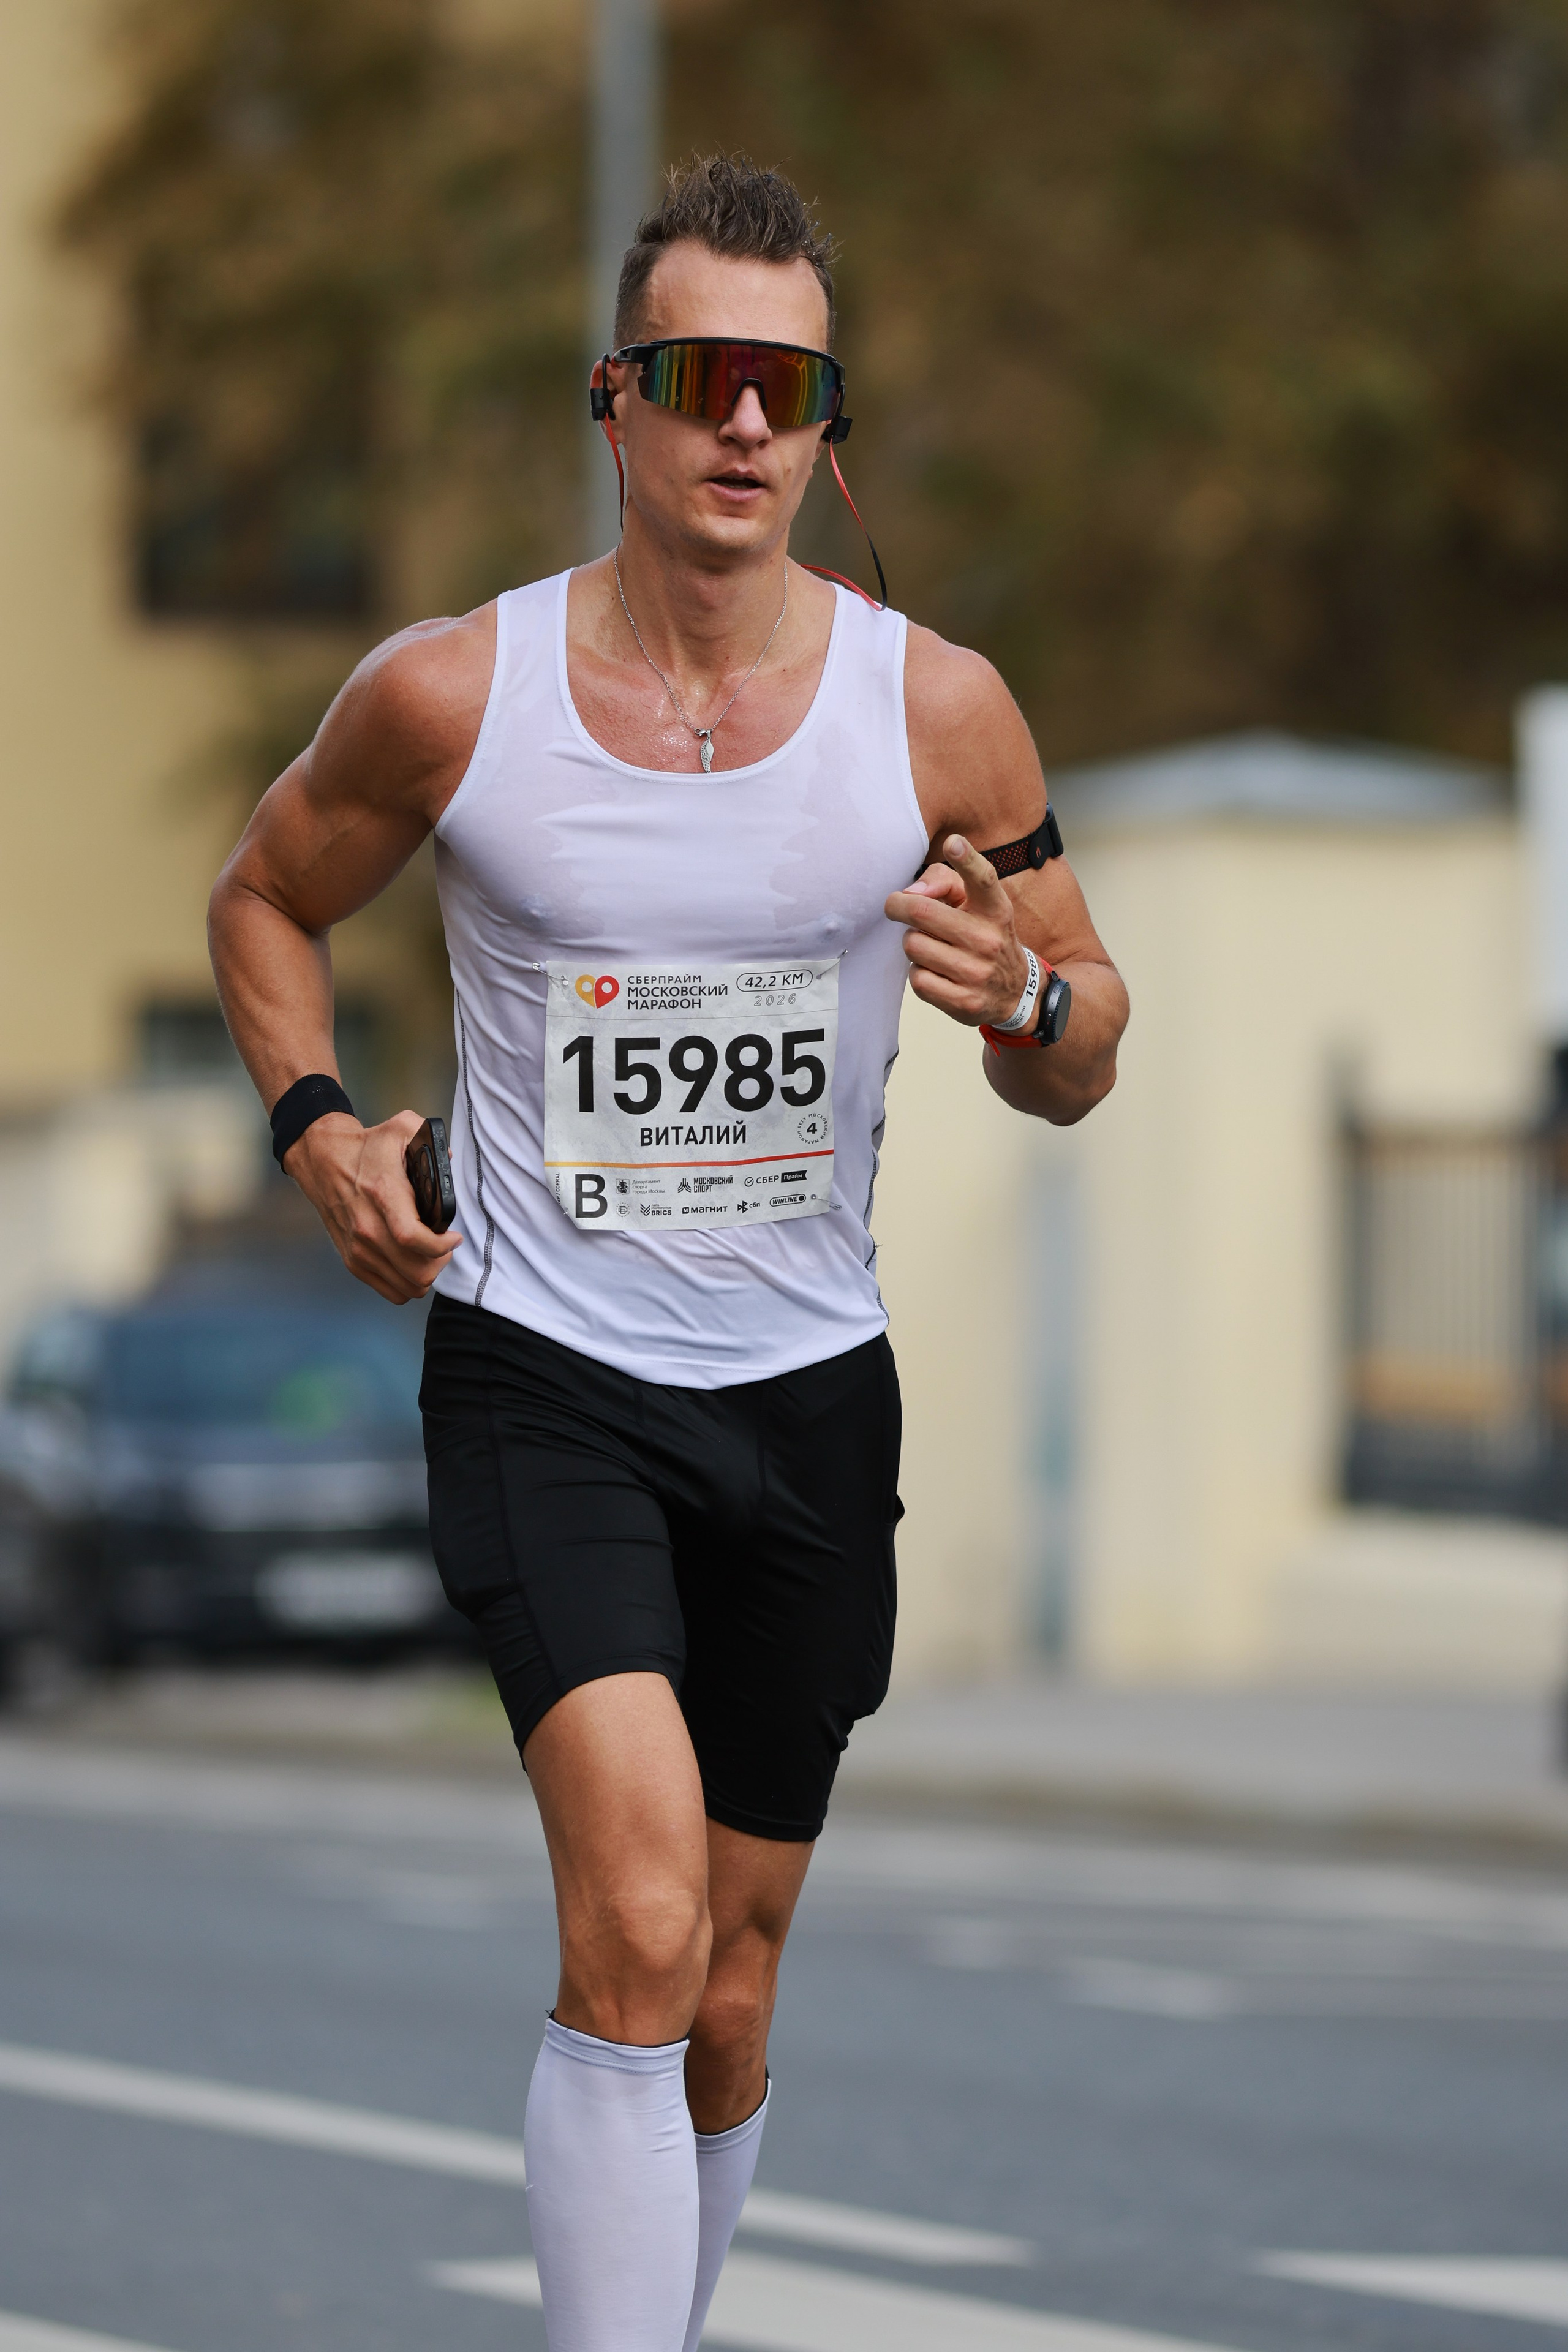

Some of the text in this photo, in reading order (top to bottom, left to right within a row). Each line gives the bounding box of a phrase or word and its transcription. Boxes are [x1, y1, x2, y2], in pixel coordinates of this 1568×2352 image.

[627, 973, 701, 984] СБЕРПРАЙМ
[745, 973, 804, 989] 42,2 КМ
[627, 983, 728, 997] МОСКОВСКИЙ
[627, 998, 701, 1010] МАРАФОН
[754, 993, 796, 1006] 2026
[562, 1028, 826, 1115] 15985
[640, 1120, 747, 1147] ВИТАЛИЙ
[806, 1122, 818, 1134] 4
[693, 1175, 733, 1185] МОСКОВСКИЙ
[756, 1175, 780, 1184] СБЕР
[772, 1196, 798, 1205] WINLINE
